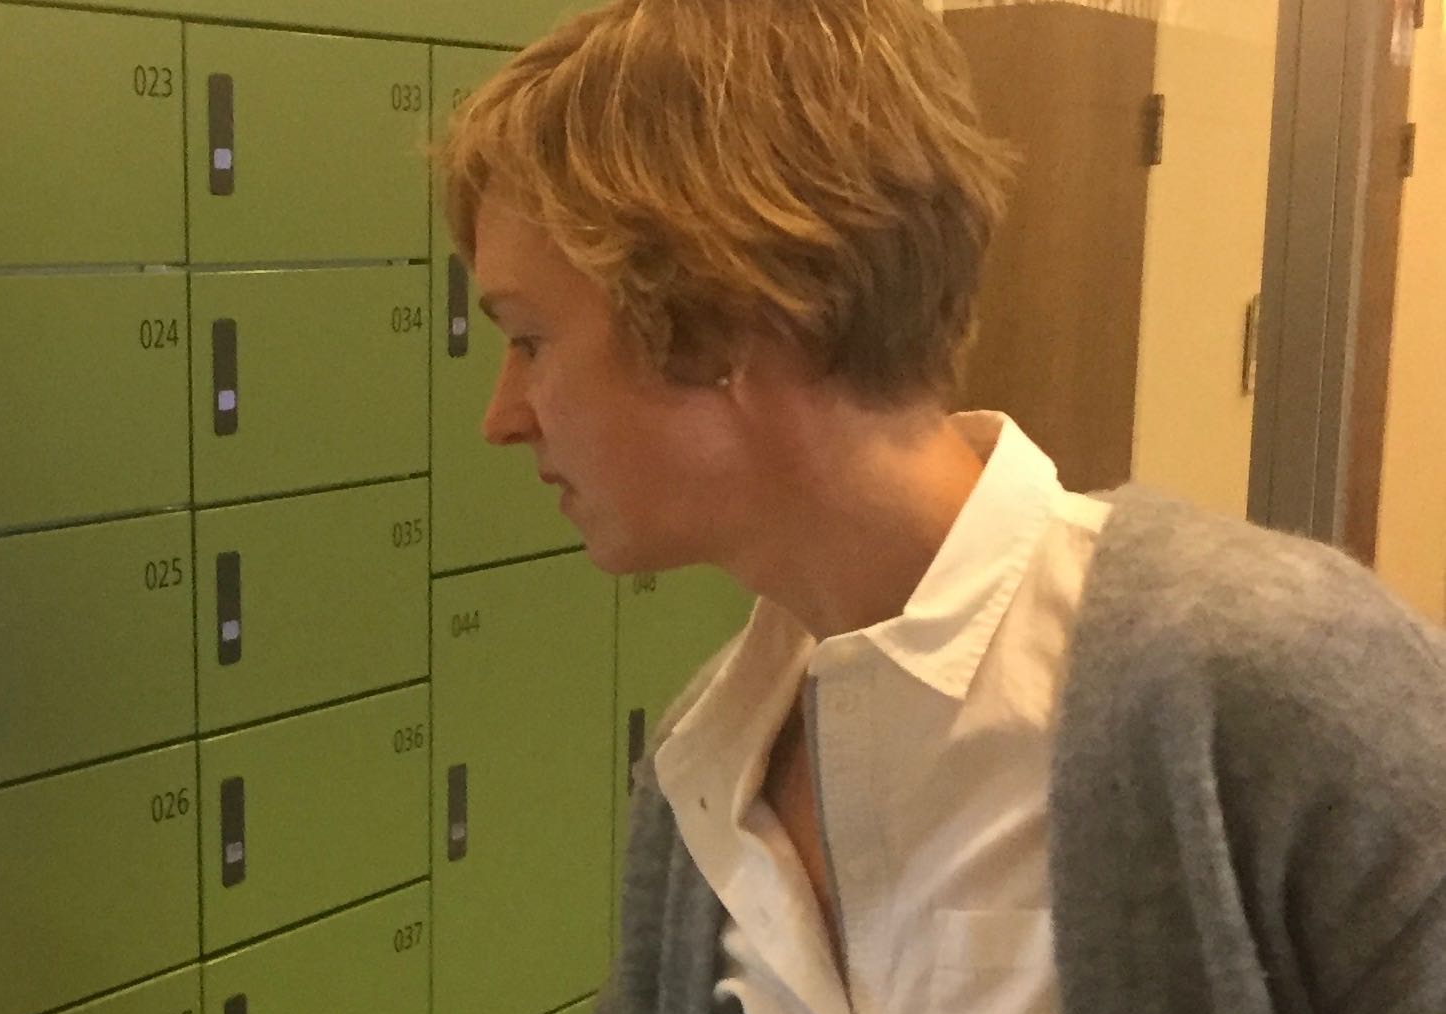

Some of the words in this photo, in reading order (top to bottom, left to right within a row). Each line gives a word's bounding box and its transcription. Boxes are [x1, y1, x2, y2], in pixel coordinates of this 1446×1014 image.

[134, 65, 173, 98] 023
[392, 83, 422, 112] 033
[139, 319, 179, 350] 024
[392, 306, 423, 333] 034
[392, 518, 423, 548] 035
[145, 557, 183, 590] 025
[393, 724, 424, 754] 036
[151, 788, 190, 823] 026
[394, 921, 423, 953] 037
